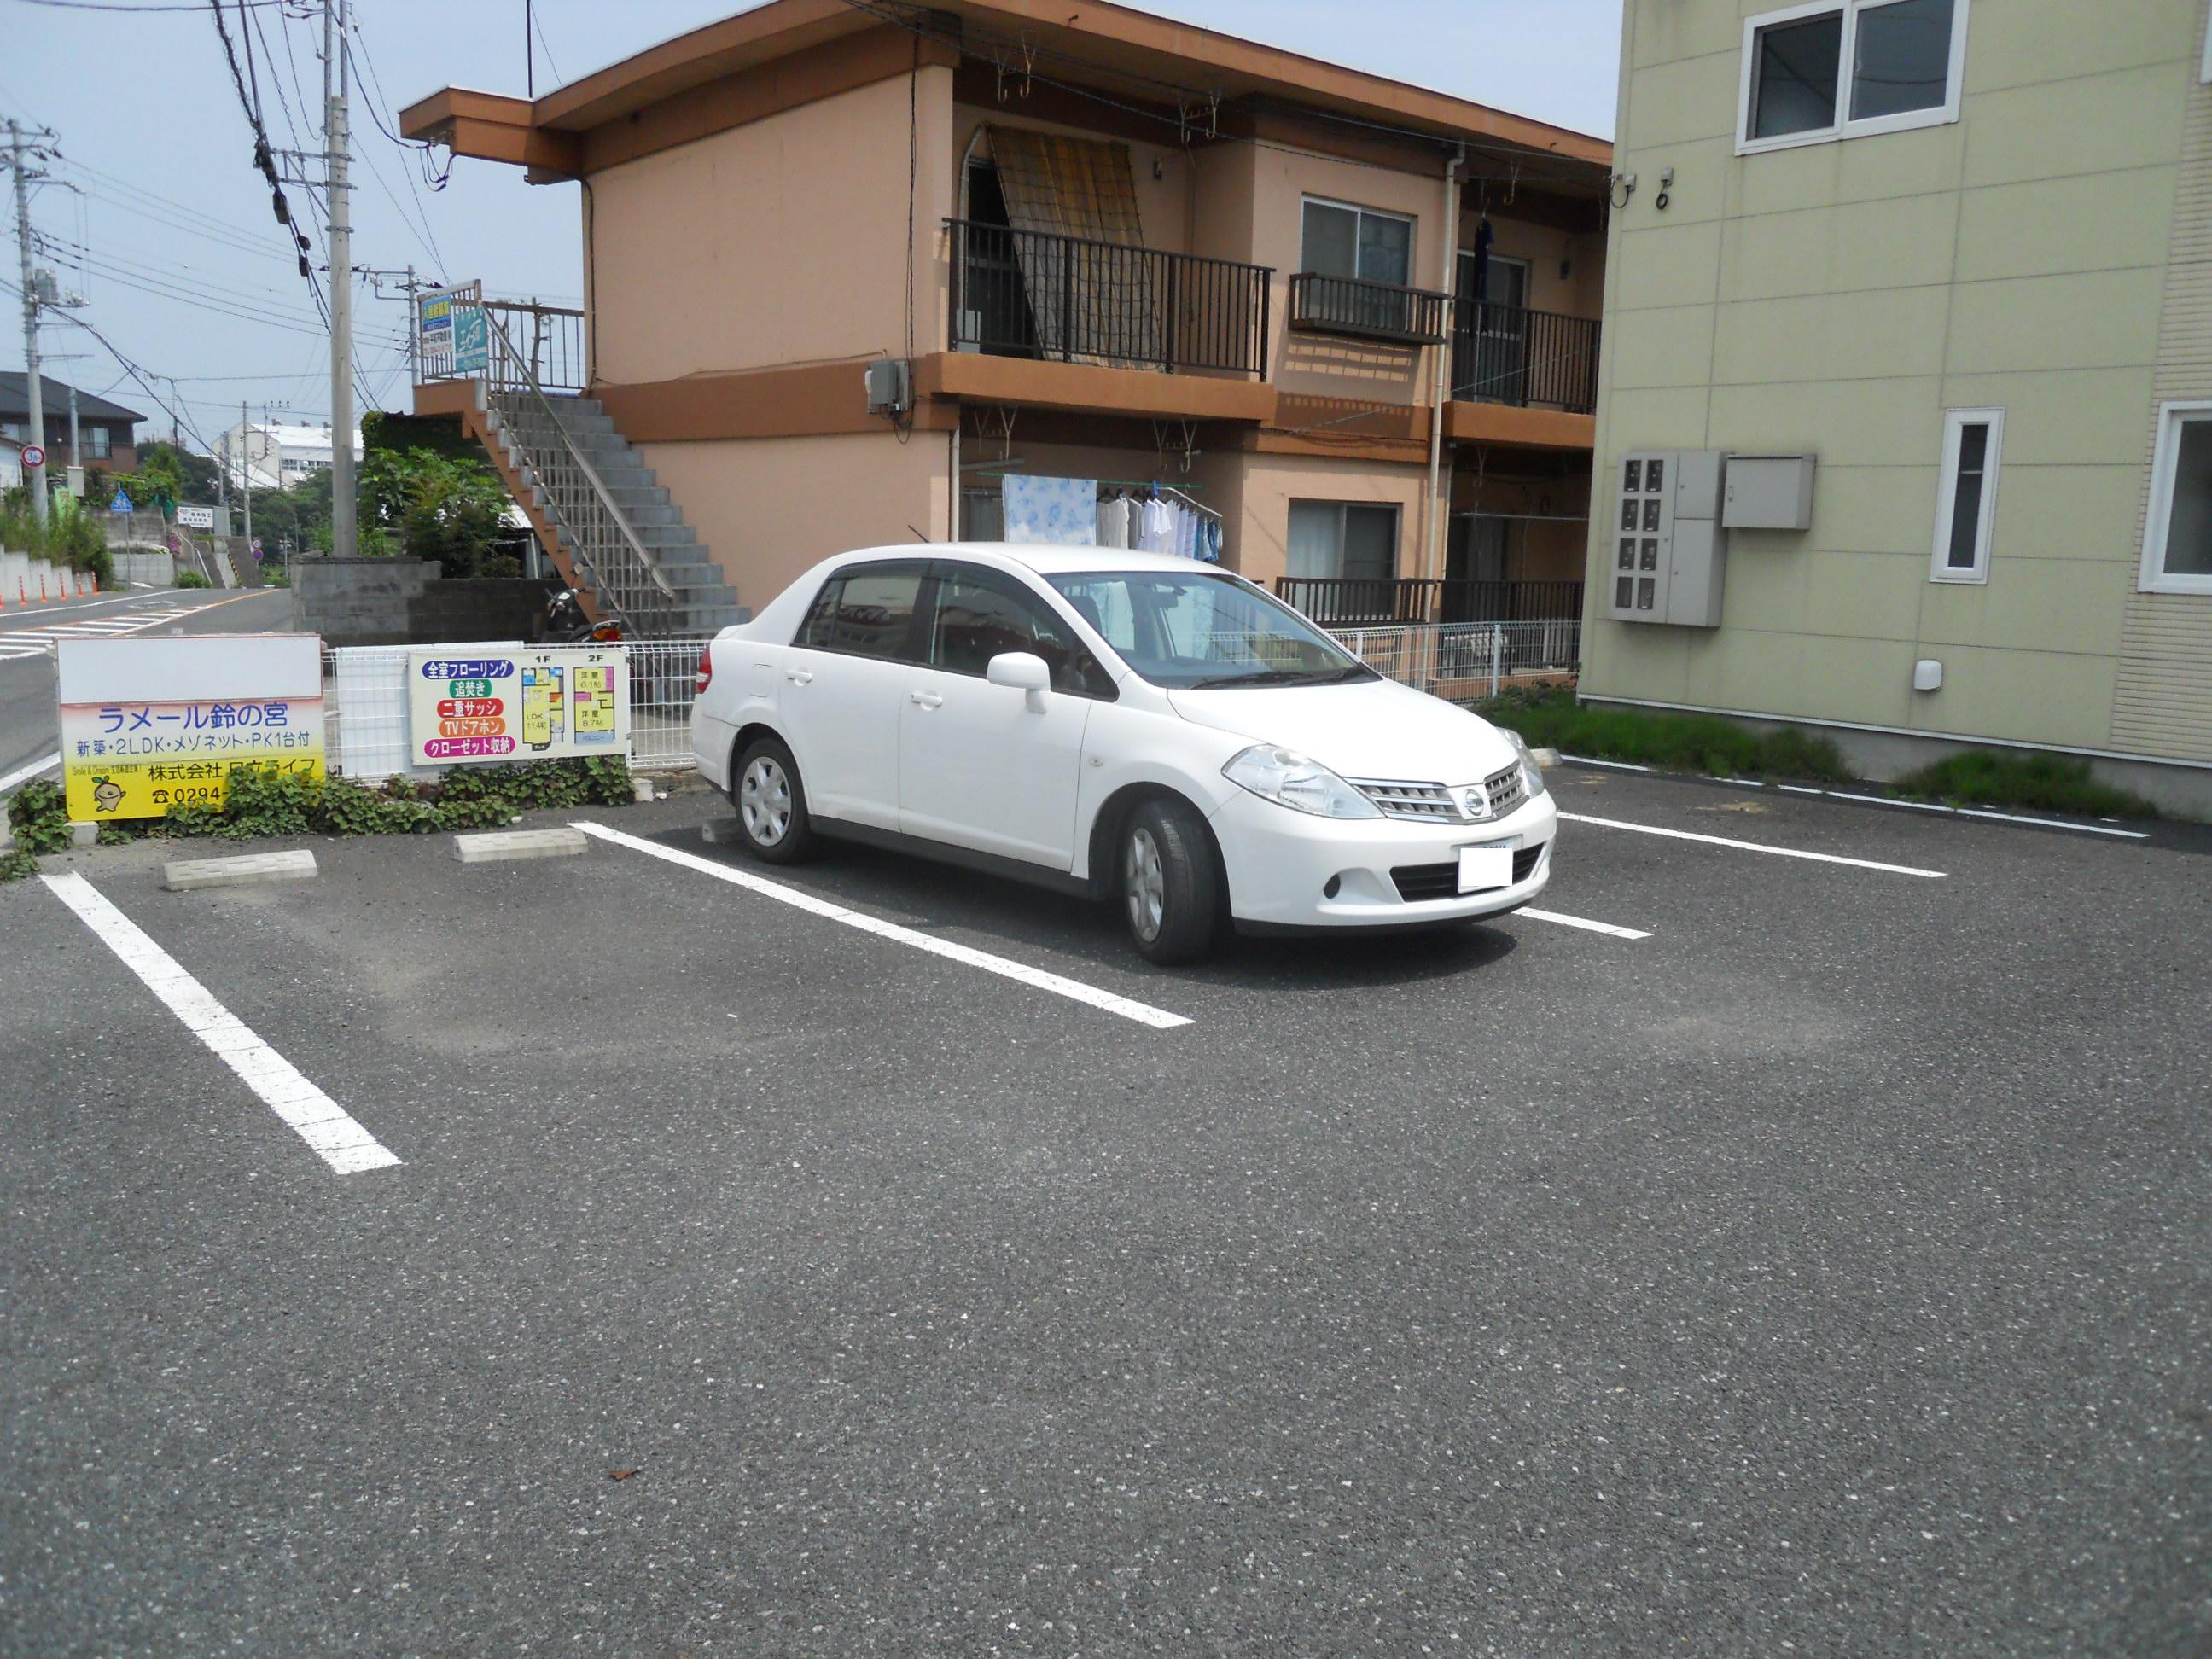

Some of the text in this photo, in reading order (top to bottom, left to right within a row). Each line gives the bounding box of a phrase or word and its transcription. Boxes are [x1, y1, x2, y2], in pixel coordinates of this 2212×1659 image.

[588, 655, 604, 663] 2F
[428, 661, 509, 678] 全室フローリング
[455, 681, 486, 698] 追焚き
[99, 702, 288, 733] ラメール鈴の宮
[443, 701, 497, 718] 二重サッシ
[445, 719, 500, 736] TVドアホン
[430, 737, 510, 757] クローゼット収納
[148, 763, 223, 782] 株式会社
